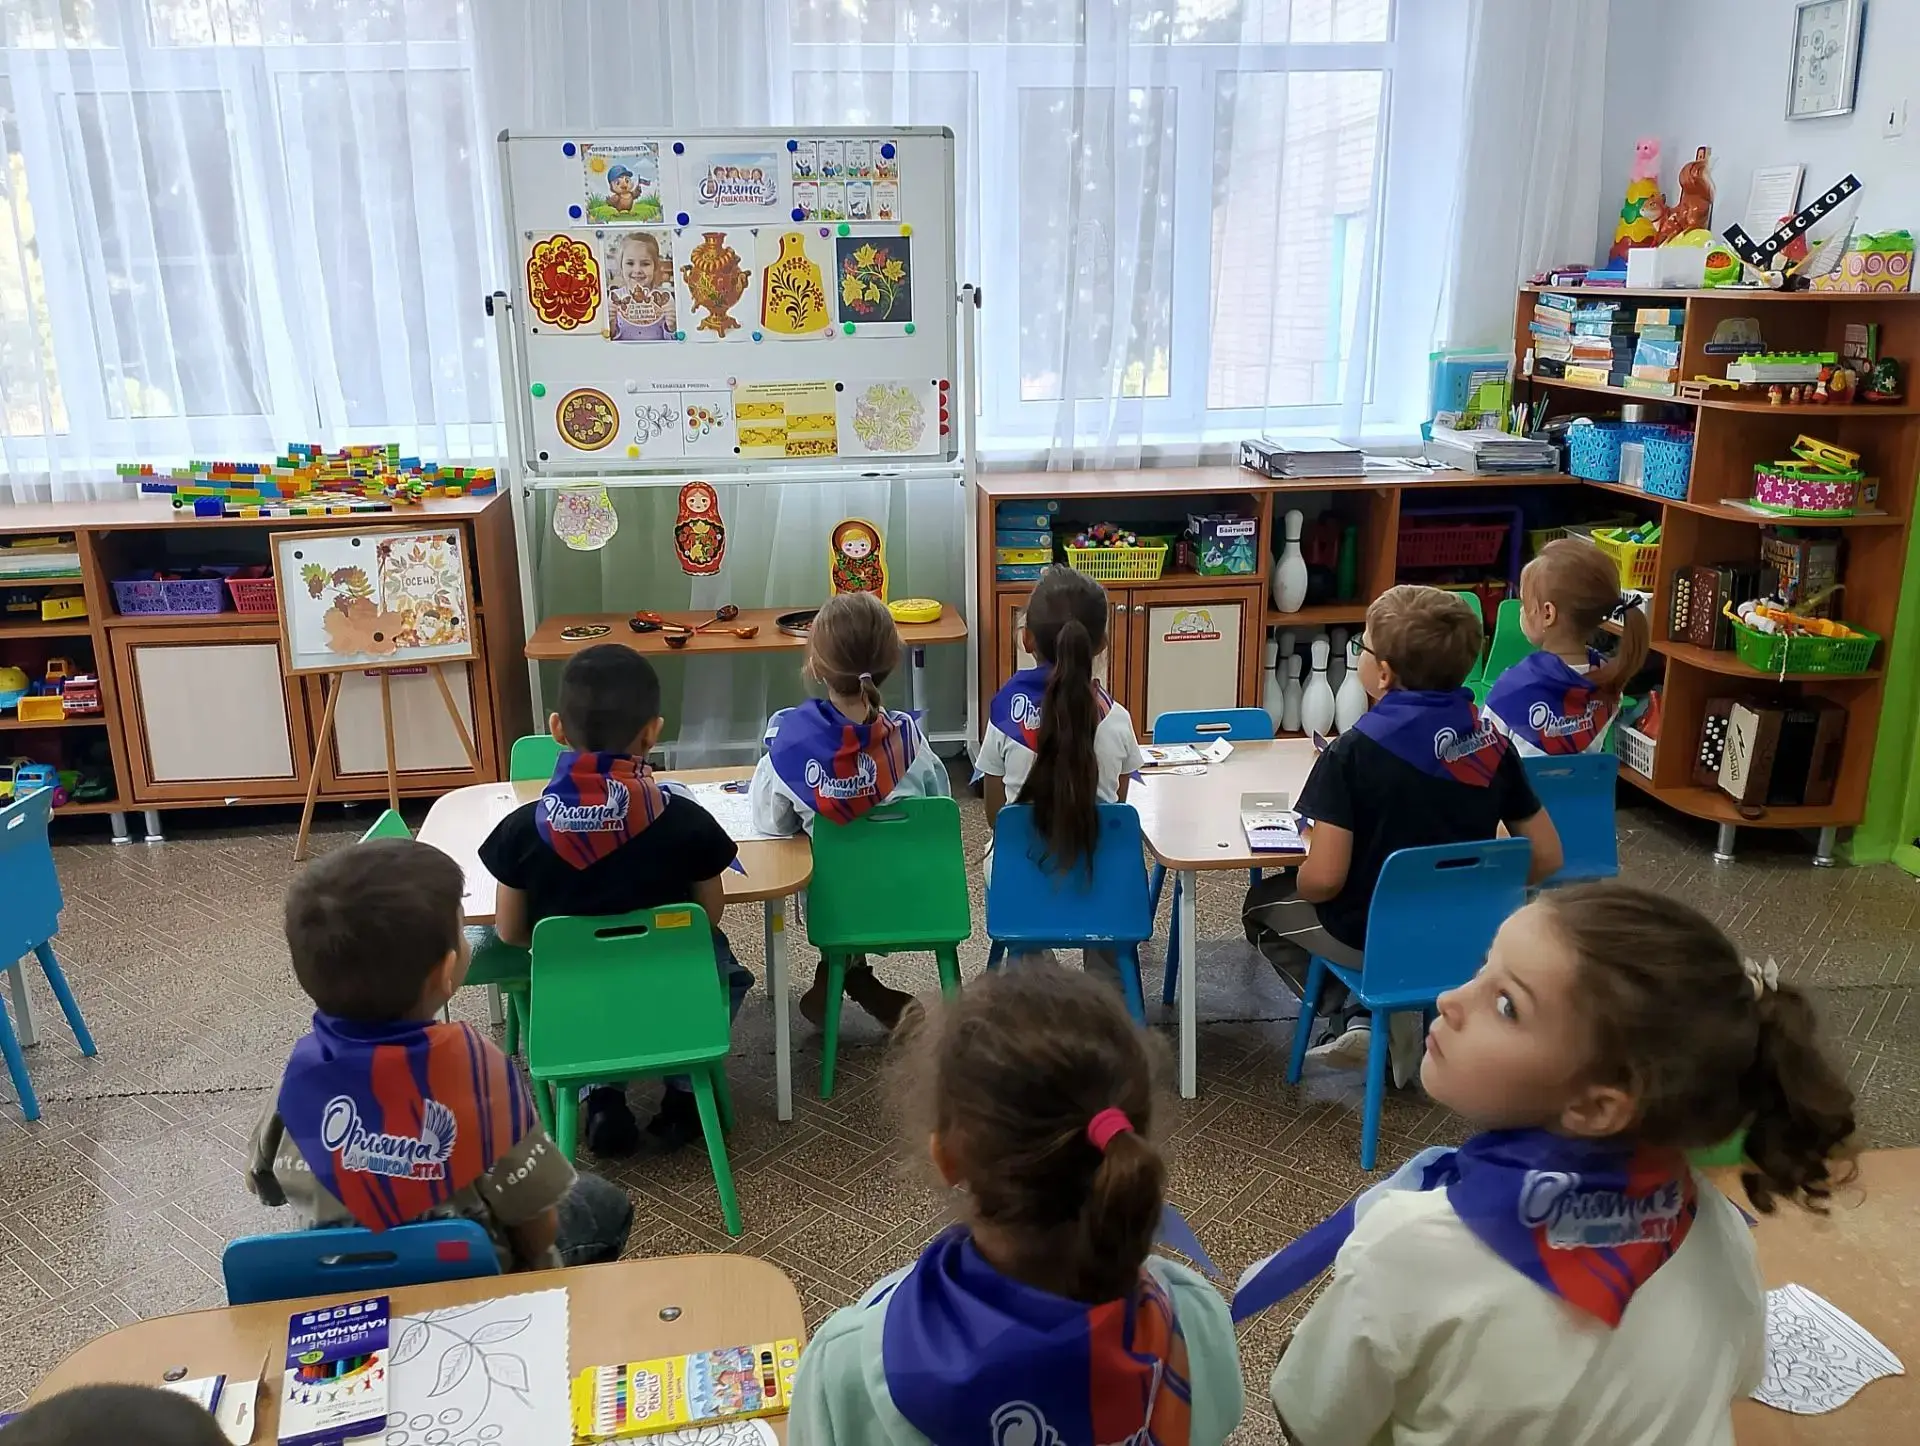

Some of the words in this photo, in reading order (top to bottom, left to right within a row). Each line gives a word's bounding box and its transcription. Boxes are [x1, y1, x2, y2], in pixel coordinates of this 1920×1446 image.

[405, 576, 436, 587] ОСЕНЬ
[324, 1097, 433, 1160] Орлята
[345, 1152, 444, 1178] ДОШКОЛЯТА
[505, 1143, 547, 1185] don't
[291, 1317, 388, 1346] КАРАНДАШИ
[309, 1331, 369, 1351] ЦВЕТНЫЕ
[635, 1370, 649, 1420] COLOURED
[648, 1374, 662, 1413] PENCILS
